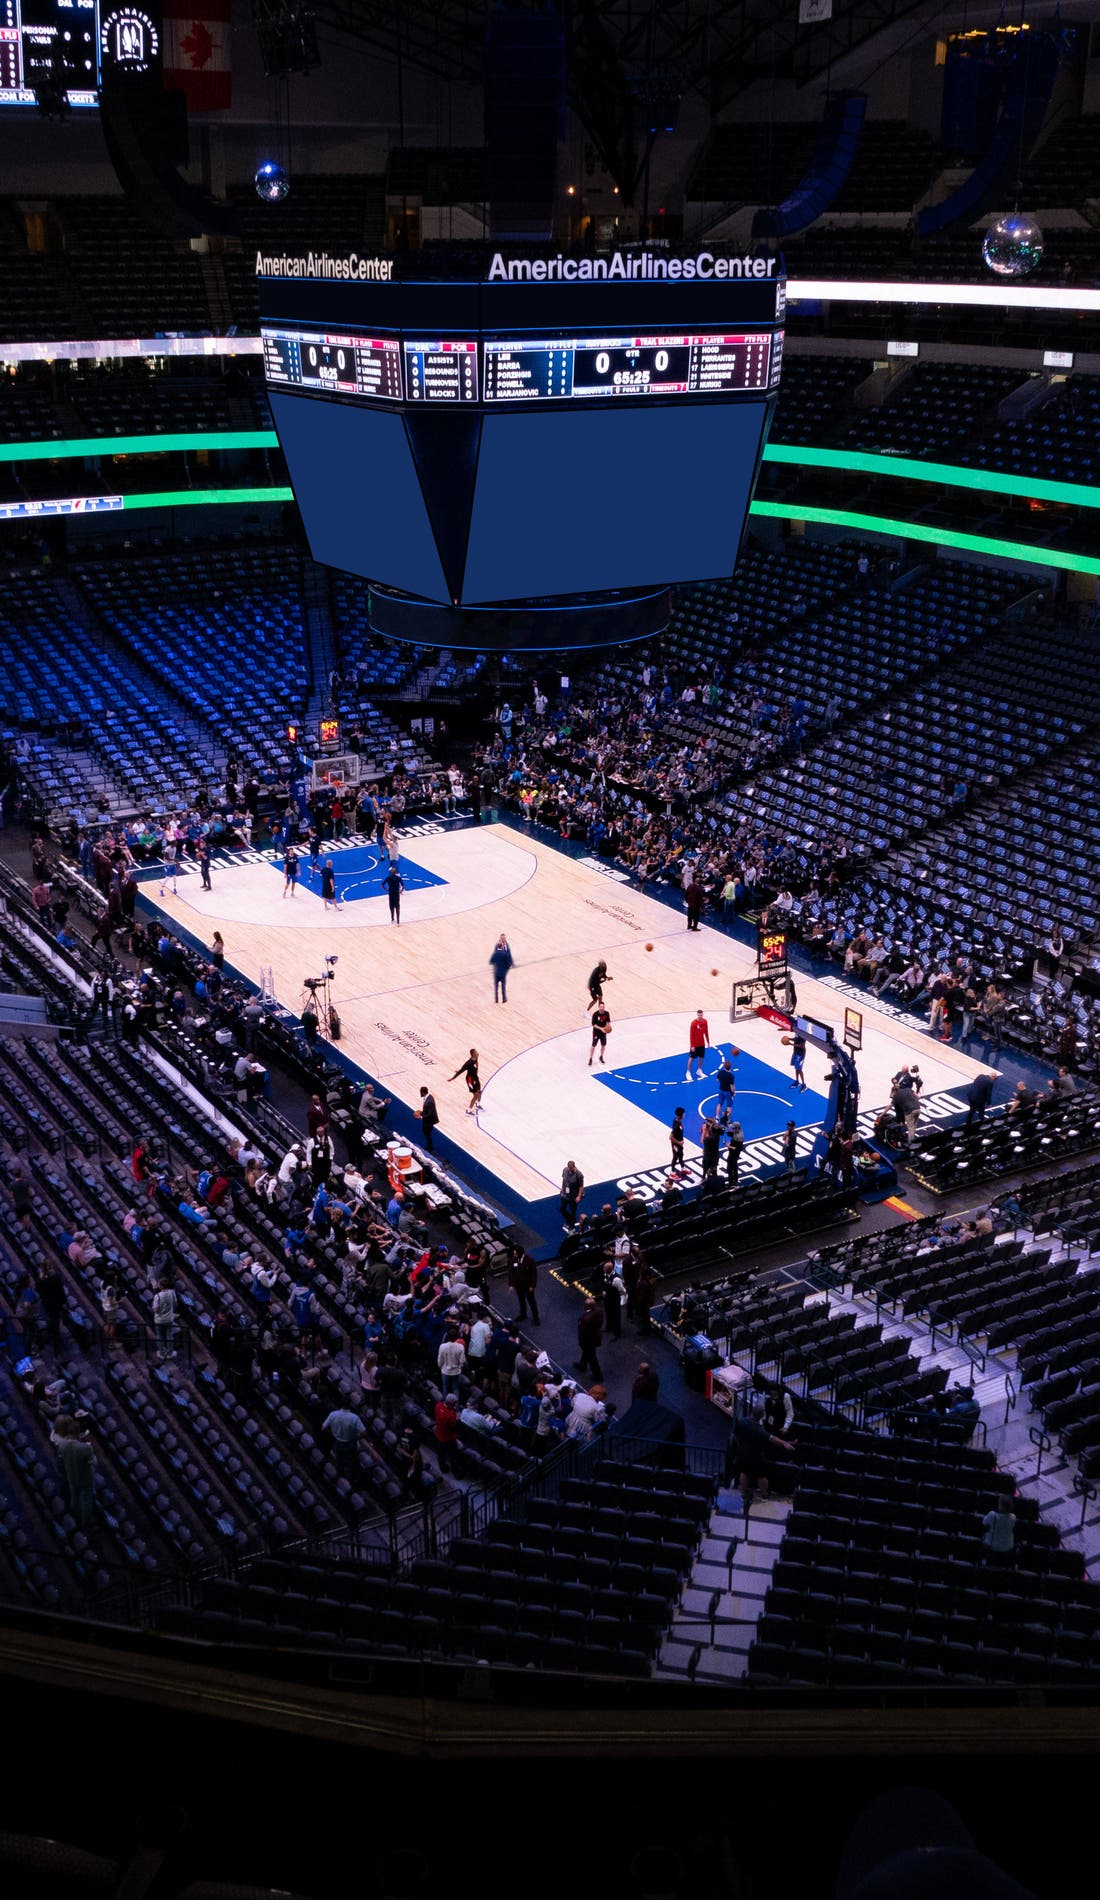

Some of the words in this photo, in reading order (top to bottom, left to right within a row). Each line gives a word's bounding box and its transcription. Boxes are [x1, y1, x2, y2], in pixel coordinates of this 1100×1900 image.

[256, 251, 393, 281] AmericanAirlinesCenter
[488, 252, 776, 281] AmericanAirlinesCenter
[658, 337, 684, 345] BLAZERS
[701, 346, 720, 354] HOOD
[309, 346, 317, 367] 0
[337, 349, 345, 370] 0
[428, 356, 454, 364] ASSISTS
[464, 356, 471, 365] 4
[655, 350, 669, 372] 0
[595, 352, 610, 374] 0
[412, 367, 419, 376] 0
[424, 368, 458, 376] REBOUNDS
[465, 367, 472, 376] 0
[412, 378, 419, 387] 0
[425, 379, 459, 387] TURNOVERS
[465, 379, 472, 388] 0
[497, 380, 524, 388] POWELL
[613, 371, 651, 385] 65:25
[413, 389, 420, 398] 0
[465, 390, 472, 399] 0
[497, 389, 539, 398] MARJANOVIC
[323, 728, 336, 740] 24
[763, 935, 785, 947] 65:24
[765, 945, 783, 961] 24
